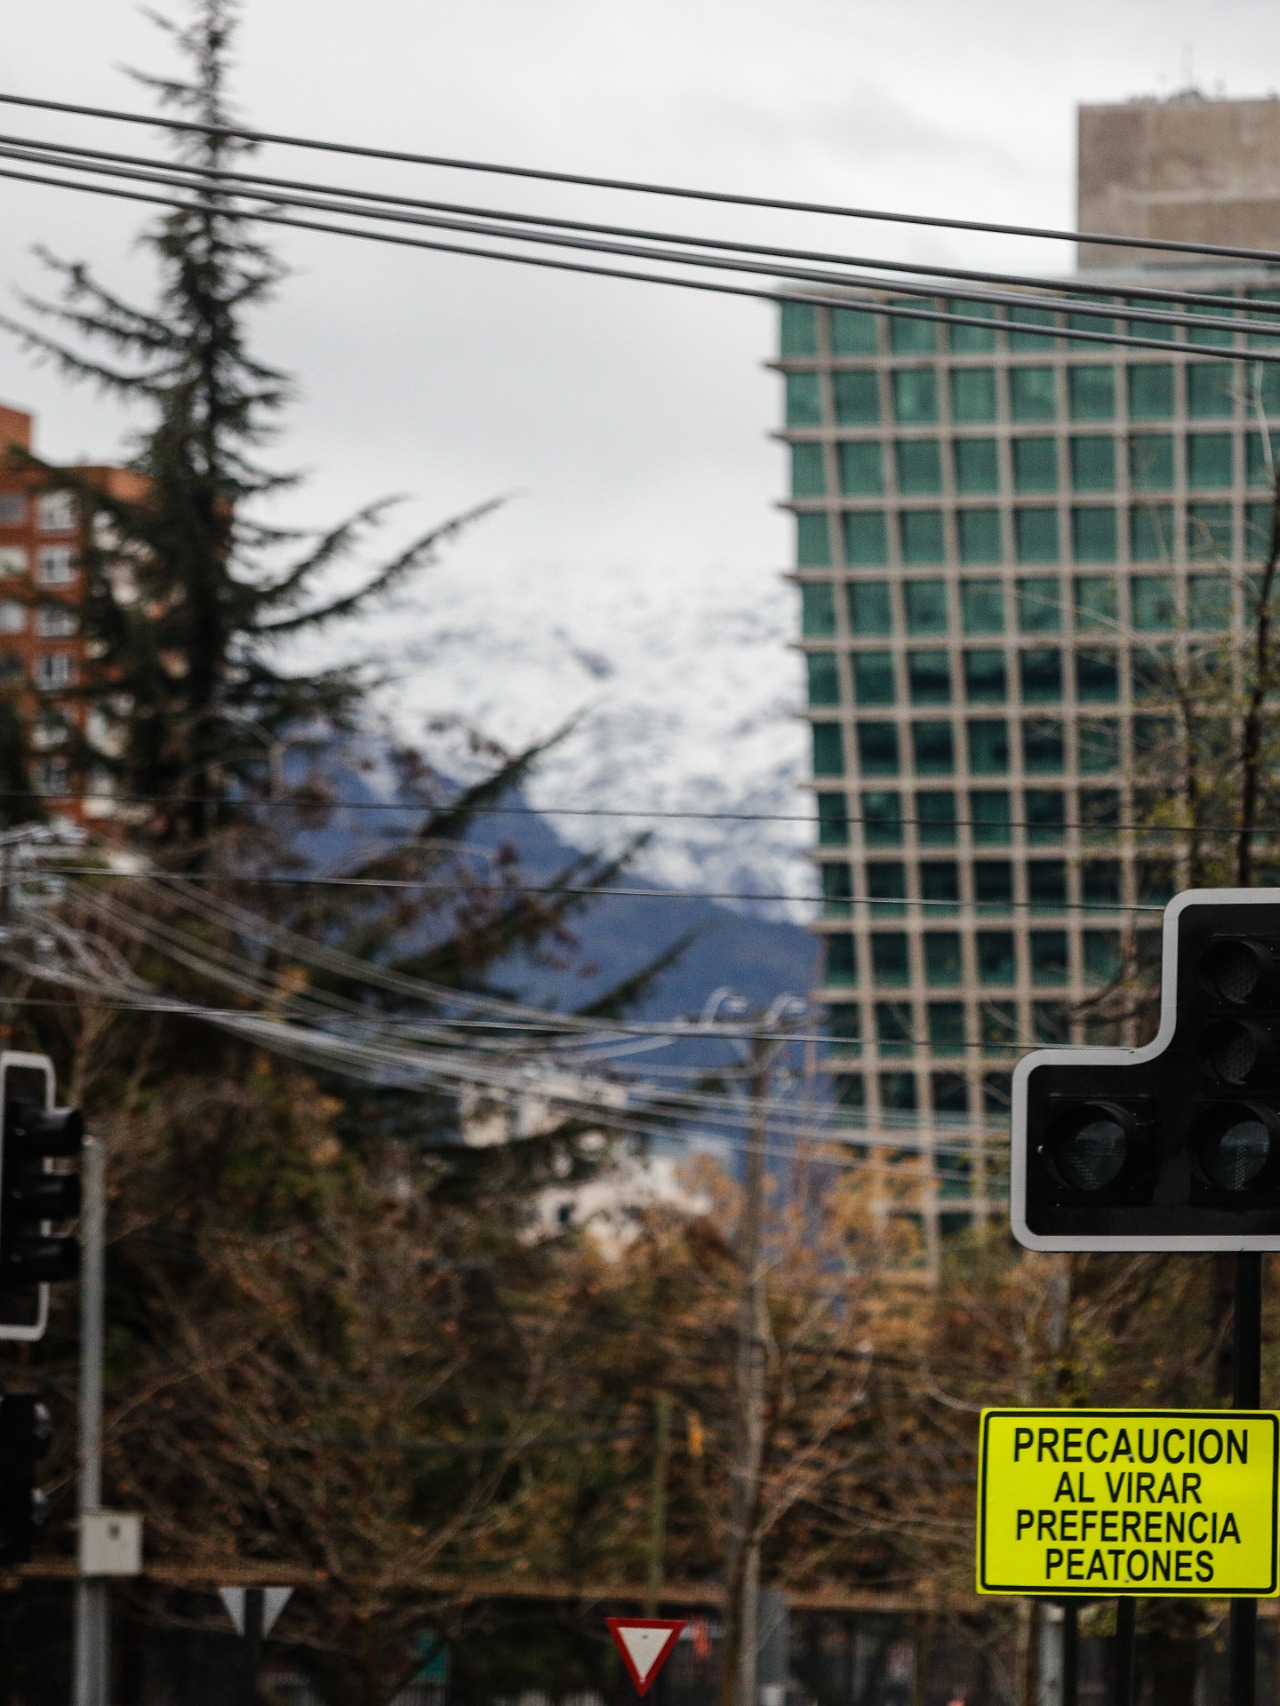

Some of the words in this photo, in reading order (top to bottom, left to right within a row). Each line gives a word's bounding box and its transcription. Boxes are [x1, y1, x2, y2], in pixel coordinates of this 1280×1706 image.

[1013, 1427, 1248, 1464] PRECAUCION
[1053, 1471, 1095, 1503] AL
[1105, 1471, 1202, 1504] VIRAR
[1016, 1509, 1242, 1544] PREFERENCIA
[1045, 1548, 1214, 1582] PEATONES
